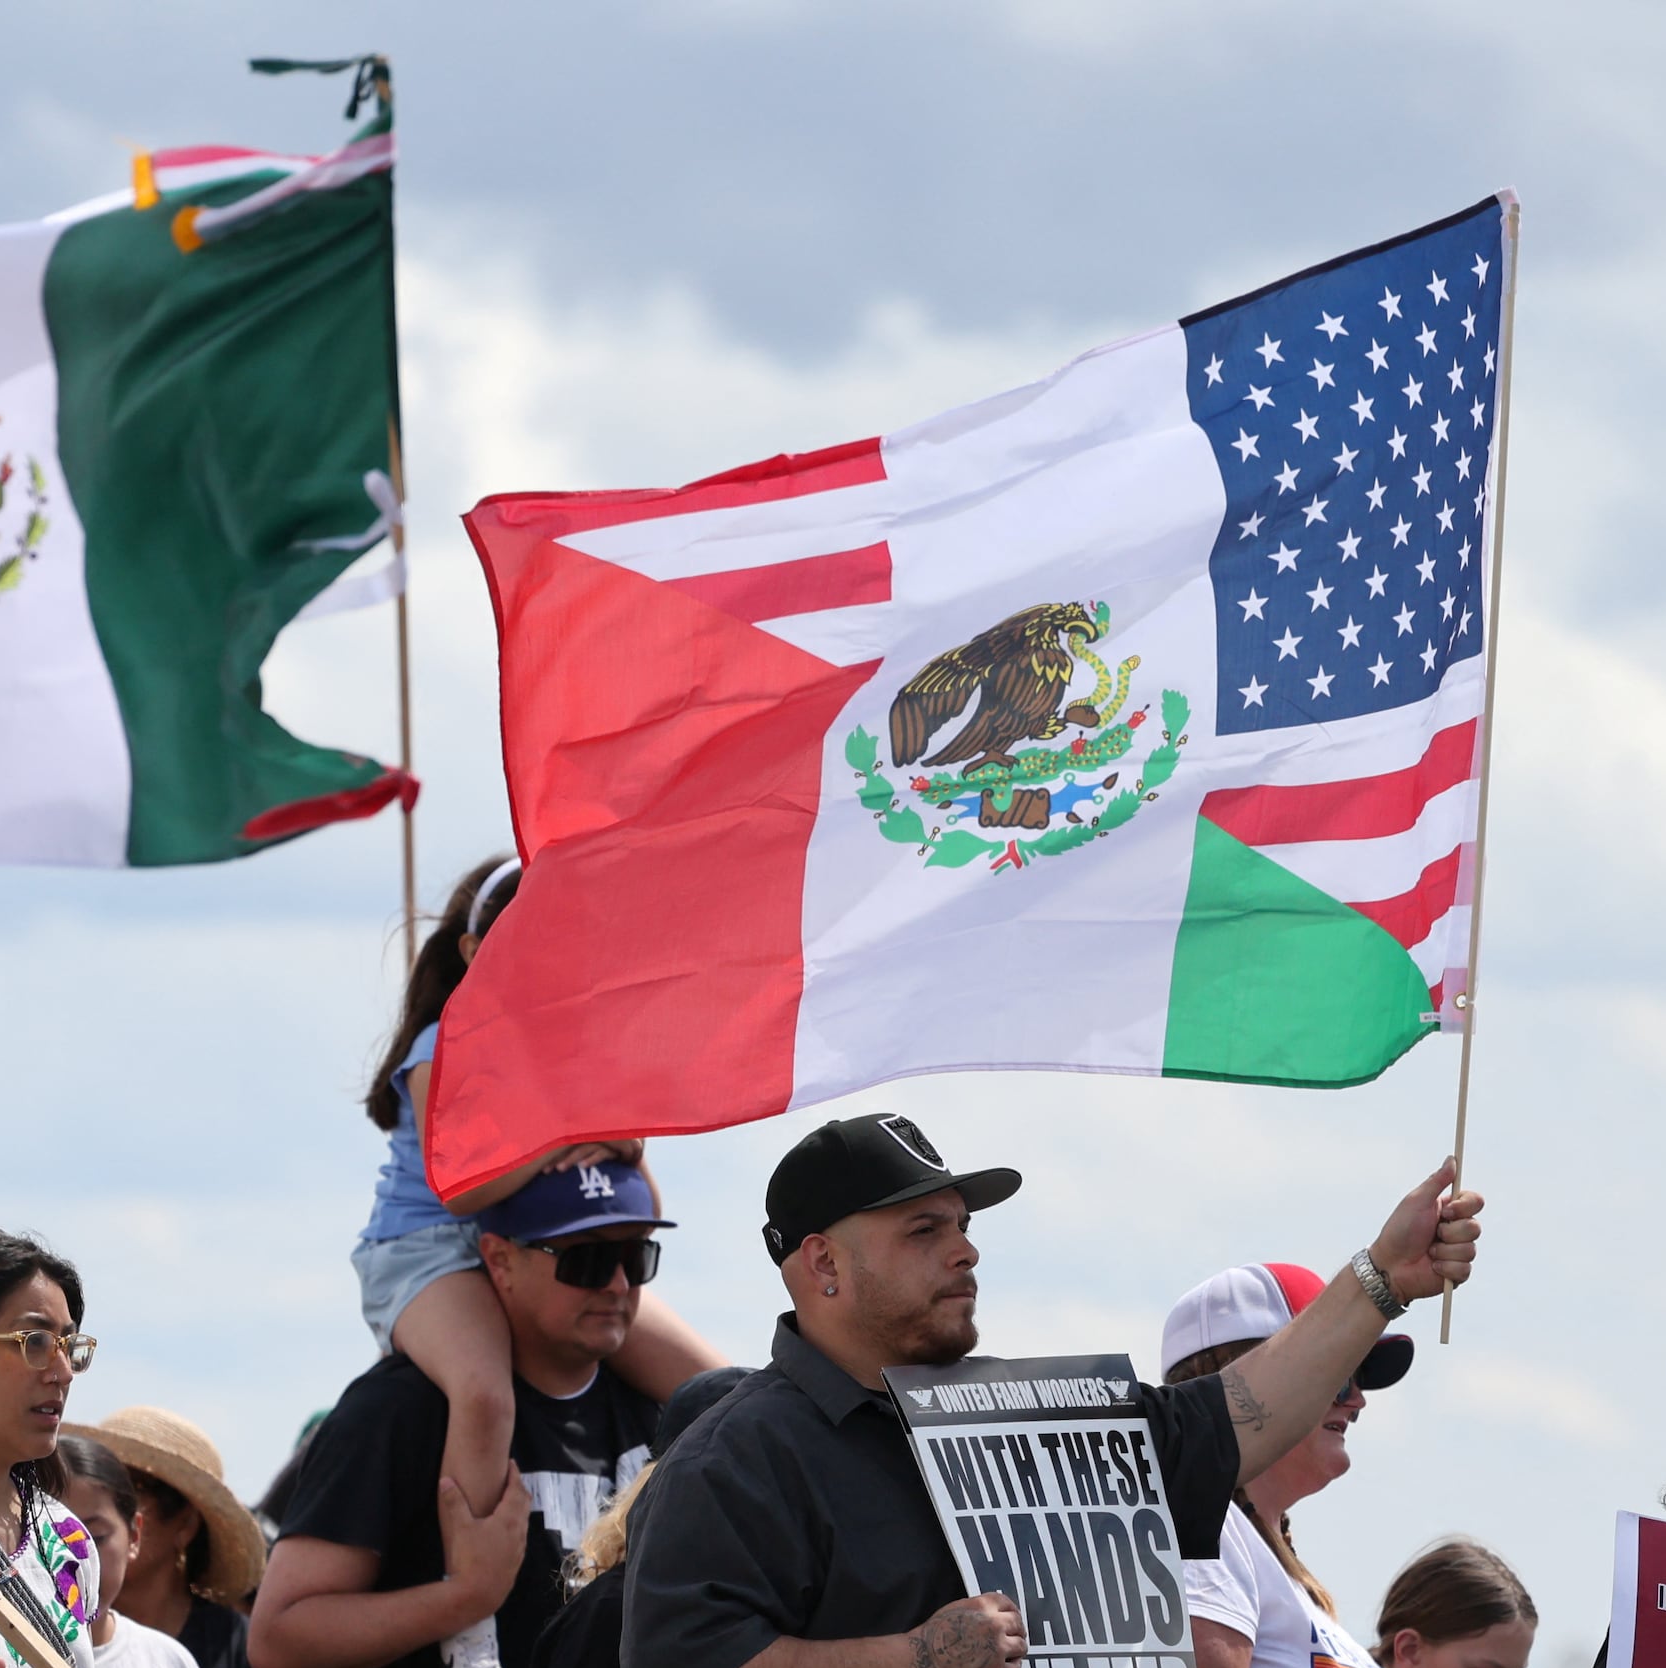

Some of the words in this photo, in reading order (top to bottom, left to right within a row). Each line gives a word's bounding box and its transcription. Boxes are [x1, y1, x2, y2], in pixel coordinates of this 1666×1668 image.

[933, 1383, 995, 1413] UNITED
[990, 1380, 1039, 1410] FARM
[1033, 1377, 1112, 1409] WORKERS
[928, 1433, 1046, 1511] WITH
[1039, 1430, 1160, 1507] THESE
[955, 1508, 1184, 1647] HANDS
